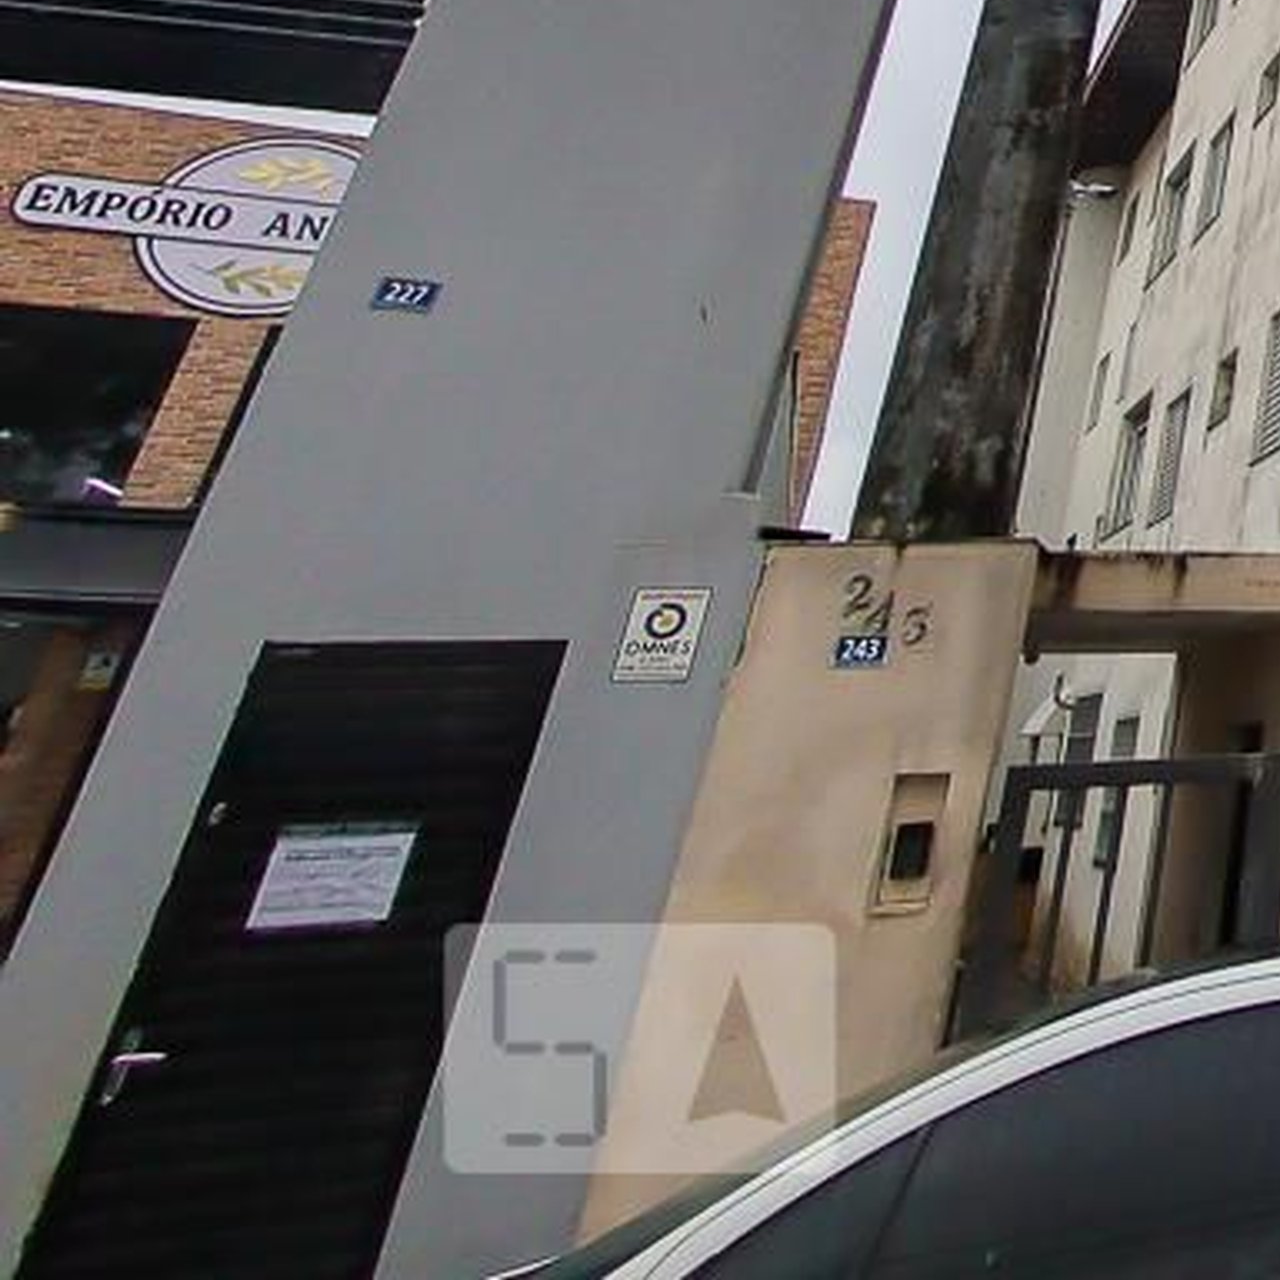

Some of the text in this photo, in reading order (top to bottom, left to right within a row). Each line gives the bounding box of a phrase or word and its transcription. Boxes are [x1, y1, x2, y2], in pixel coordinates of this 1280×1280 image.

[24, 181, 233, 231] EMPÓRIO
[385, 279, 429, 304] 227
[841, 639, 882, 660] 243
